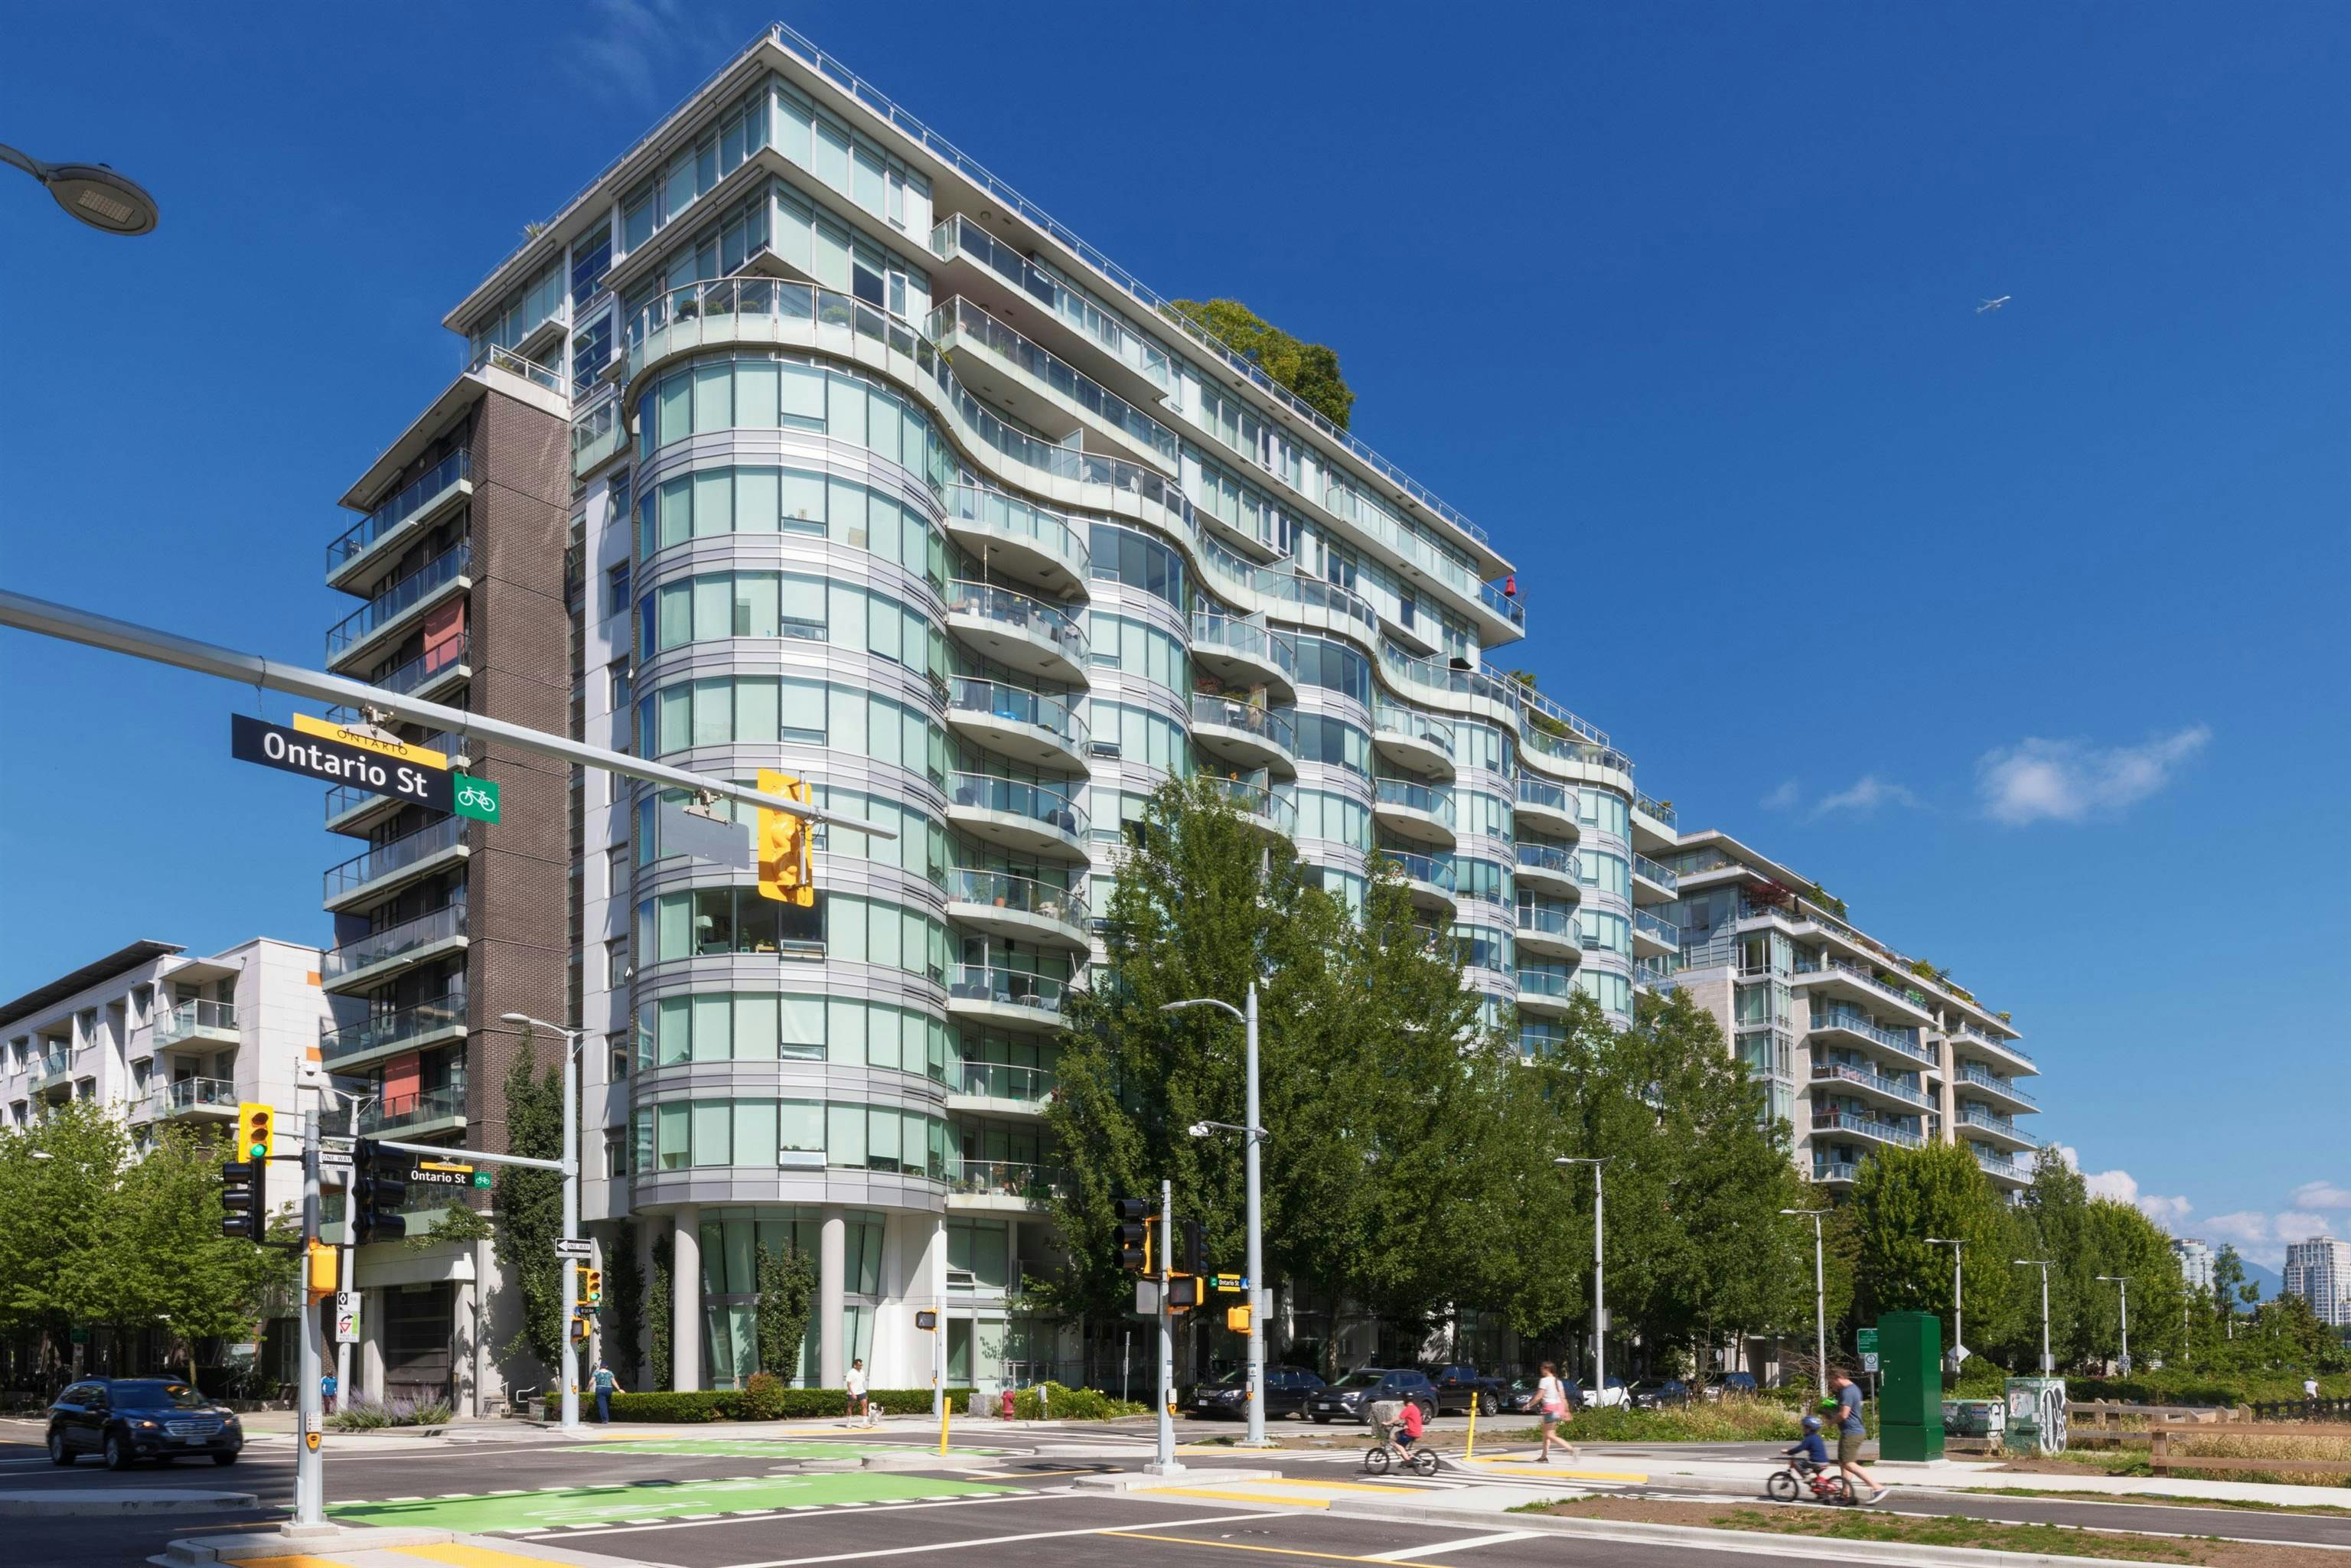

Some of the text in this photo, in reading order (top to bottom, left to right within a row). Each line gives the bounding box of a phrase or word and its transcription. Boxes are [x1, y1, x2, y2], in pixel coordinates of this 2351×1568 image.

[337, 729, 408, 755] ONTARIO
[263, 732, 428, 797] Ontario St
[411, 1170, 466, 1184] Ontario St
